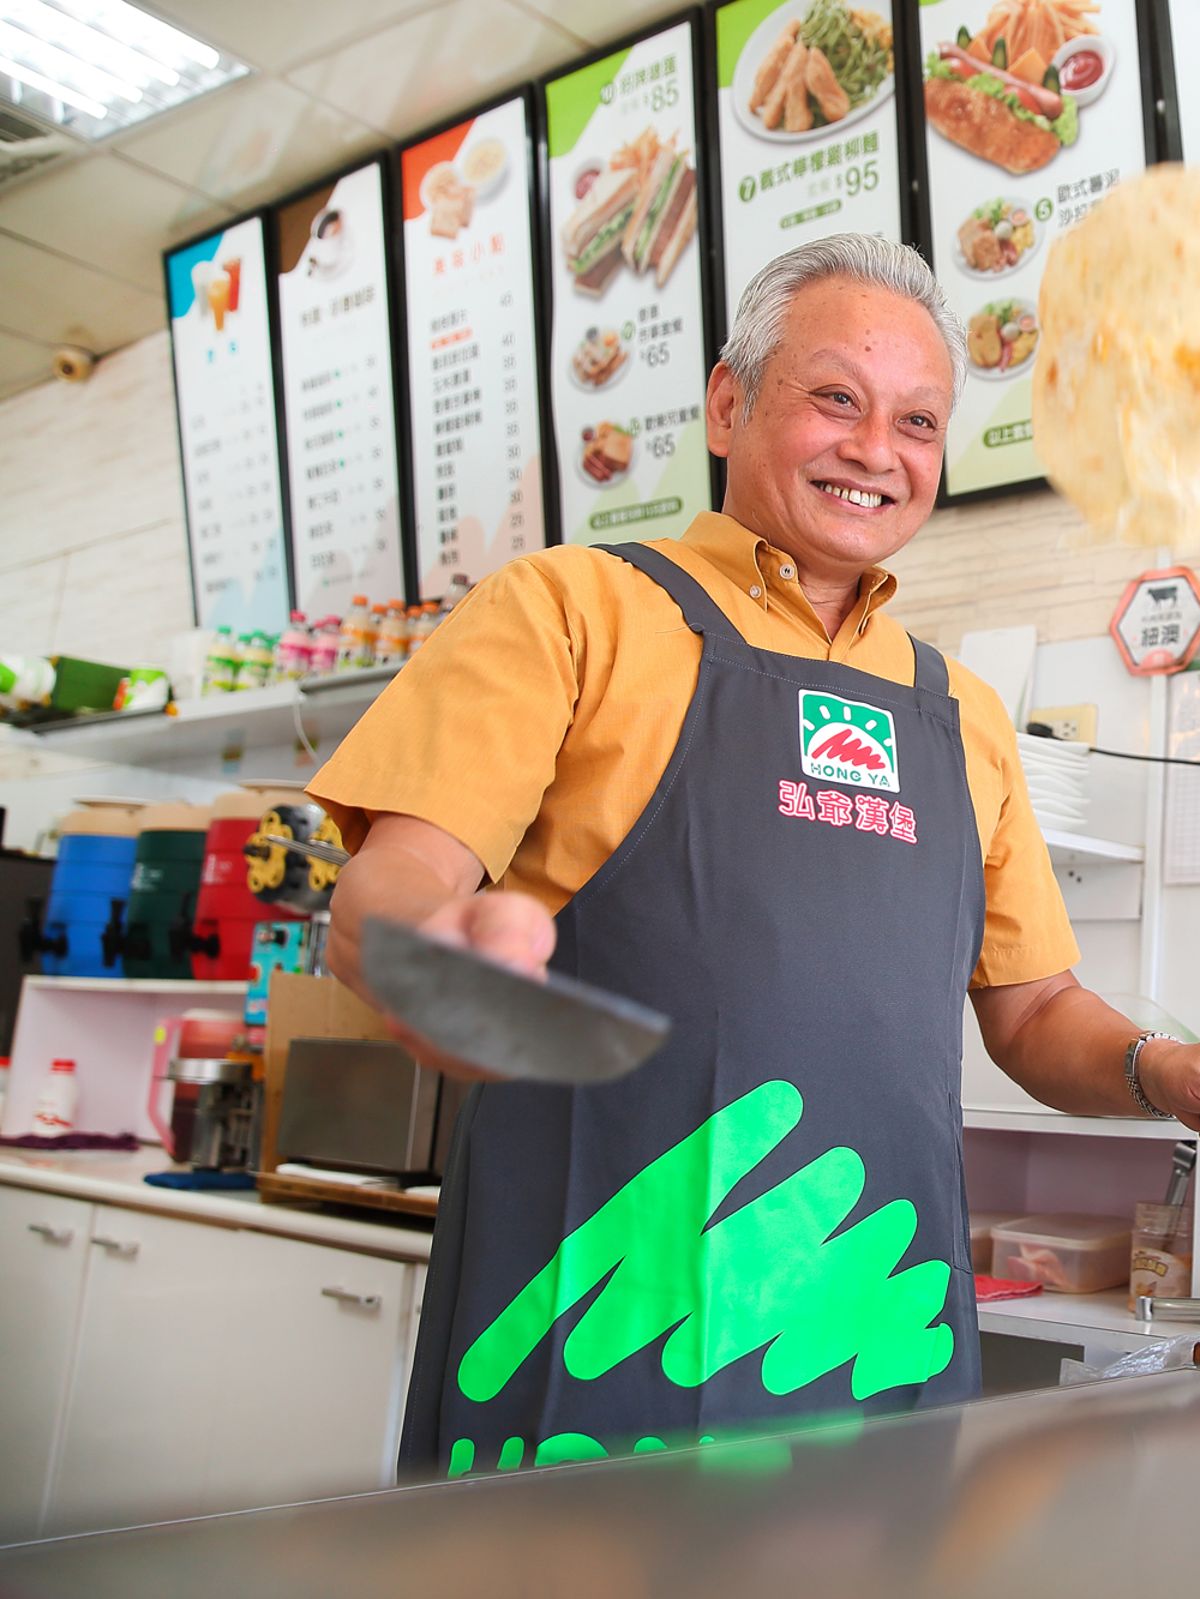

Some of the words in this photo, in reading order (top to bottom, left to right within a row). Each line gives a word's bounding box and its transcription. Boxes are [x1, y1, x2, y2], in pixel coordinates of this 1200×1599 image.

[835, 159, 879, 197] $95
[810, 762, 862, 782] HONG
[868, 773, 891, 788] YA
[778, 779, 918, 844] 弘爺漢堡
